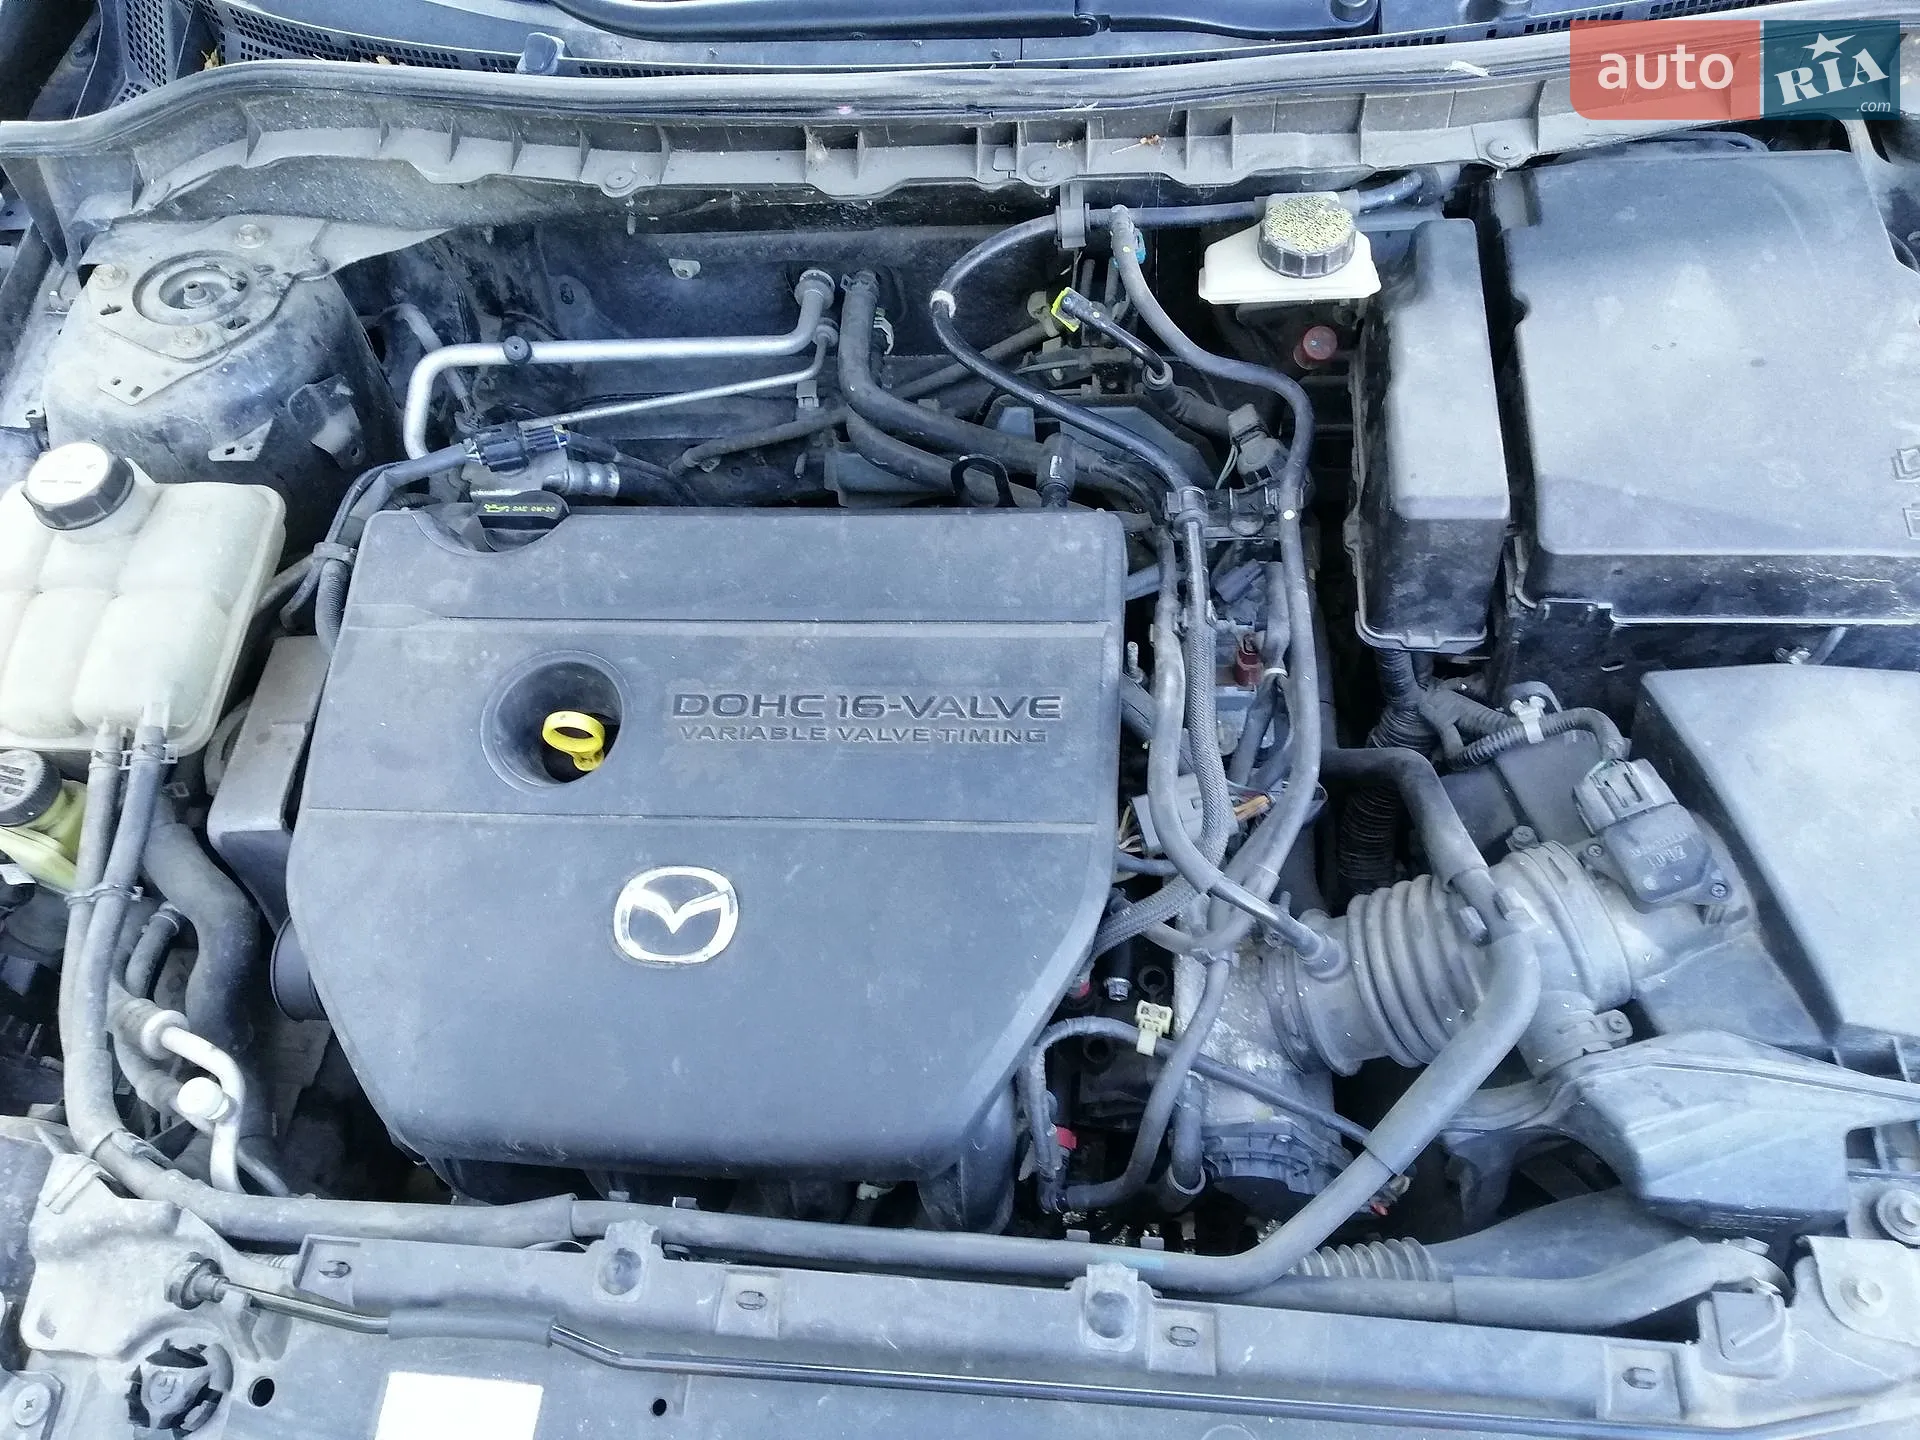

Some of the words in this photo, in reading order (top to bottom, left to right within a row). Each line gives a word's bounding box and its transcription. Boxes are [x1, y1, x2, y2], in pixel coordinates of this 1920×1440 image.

[530, 505, 556, 513] 0W-20
[672, 692, 827, 720] DOHC
[836, 694, 1063, 721] 16-VALVE
[680, 726, 828, 743] VARIABLE
[838, 726, 932, 744] VALVE
[937, 728, 1048, 745] TIMING
